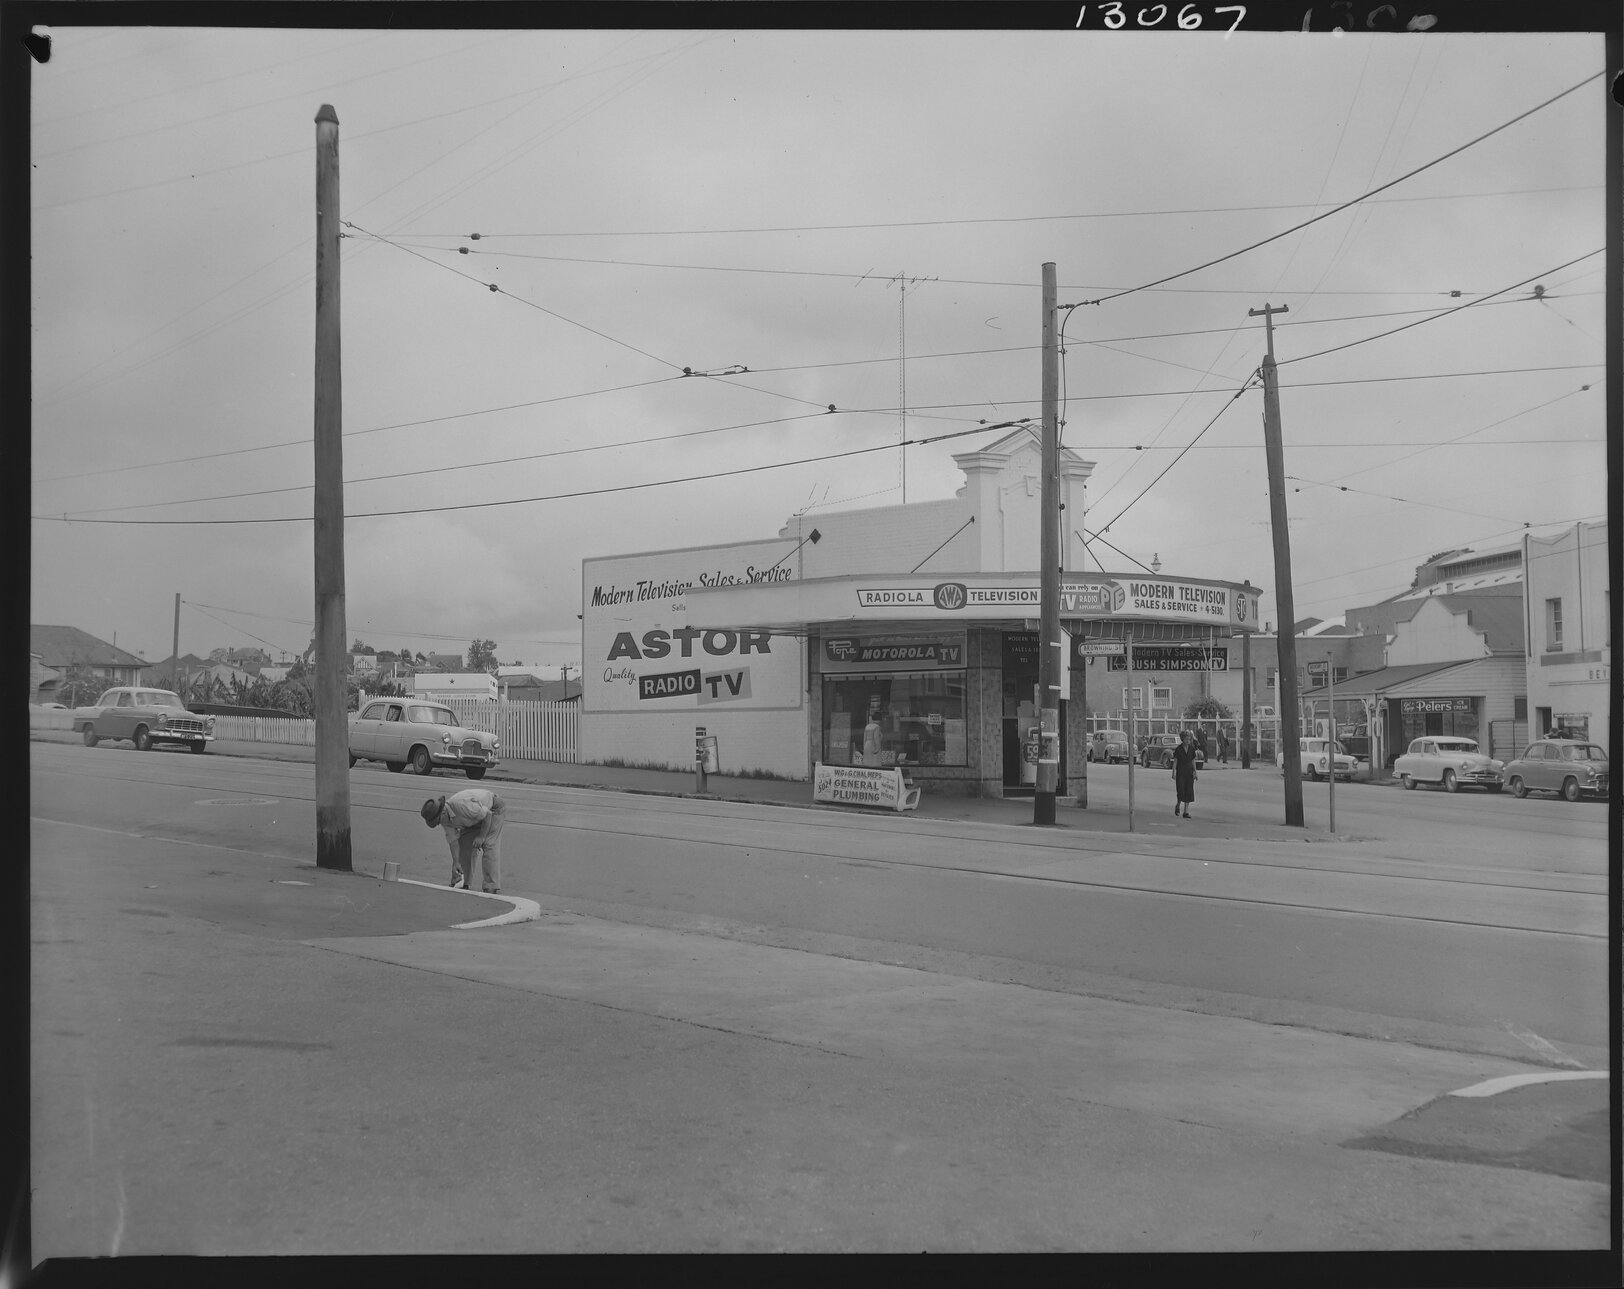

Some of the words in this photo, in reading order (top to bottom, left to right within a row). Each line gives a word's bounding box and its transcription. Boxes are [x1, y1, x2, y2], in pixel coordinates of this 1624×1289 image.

[1076, 1, 1247, 40] 13067
[592, 586, 634, 607] Modern
[699, 570, 734, 587] Sales
[745, 565, 792, 585] Service
[866, 592, 924, 603] RADIOLA
[939, 584, 962, 609] AWA
[970, 590, 1038, 602] TELEVISION
[1079, 595, 1098, 603] RADIO
[1130, 583, 1175, 600] MODERN
[1178, 586, 1226, 606] TELEVISION
[1134, 599, 1160, 609] SALES
[1161, 602, 1167, 610] &
[1167, 601, 1198, 613] SERVICE
[606, 628, 772, 661] ASTOR
[862, 646, 935, 660] MOTOROLA
[939, 648, 959, 661] TV
[1174, 648, 1194, 657] Sales
[1160, 659, 1208, 670] SIMPSON
[603, 667, 637, 686] Quality
[644, 674, 696, 695] RADIO
[705, 671, 744, 698] TV
[1415, 700, 1453, 712] Peters
[834, 779, 880, 791] GENERAL
[832, 789, 880, 802] PLUMBING
